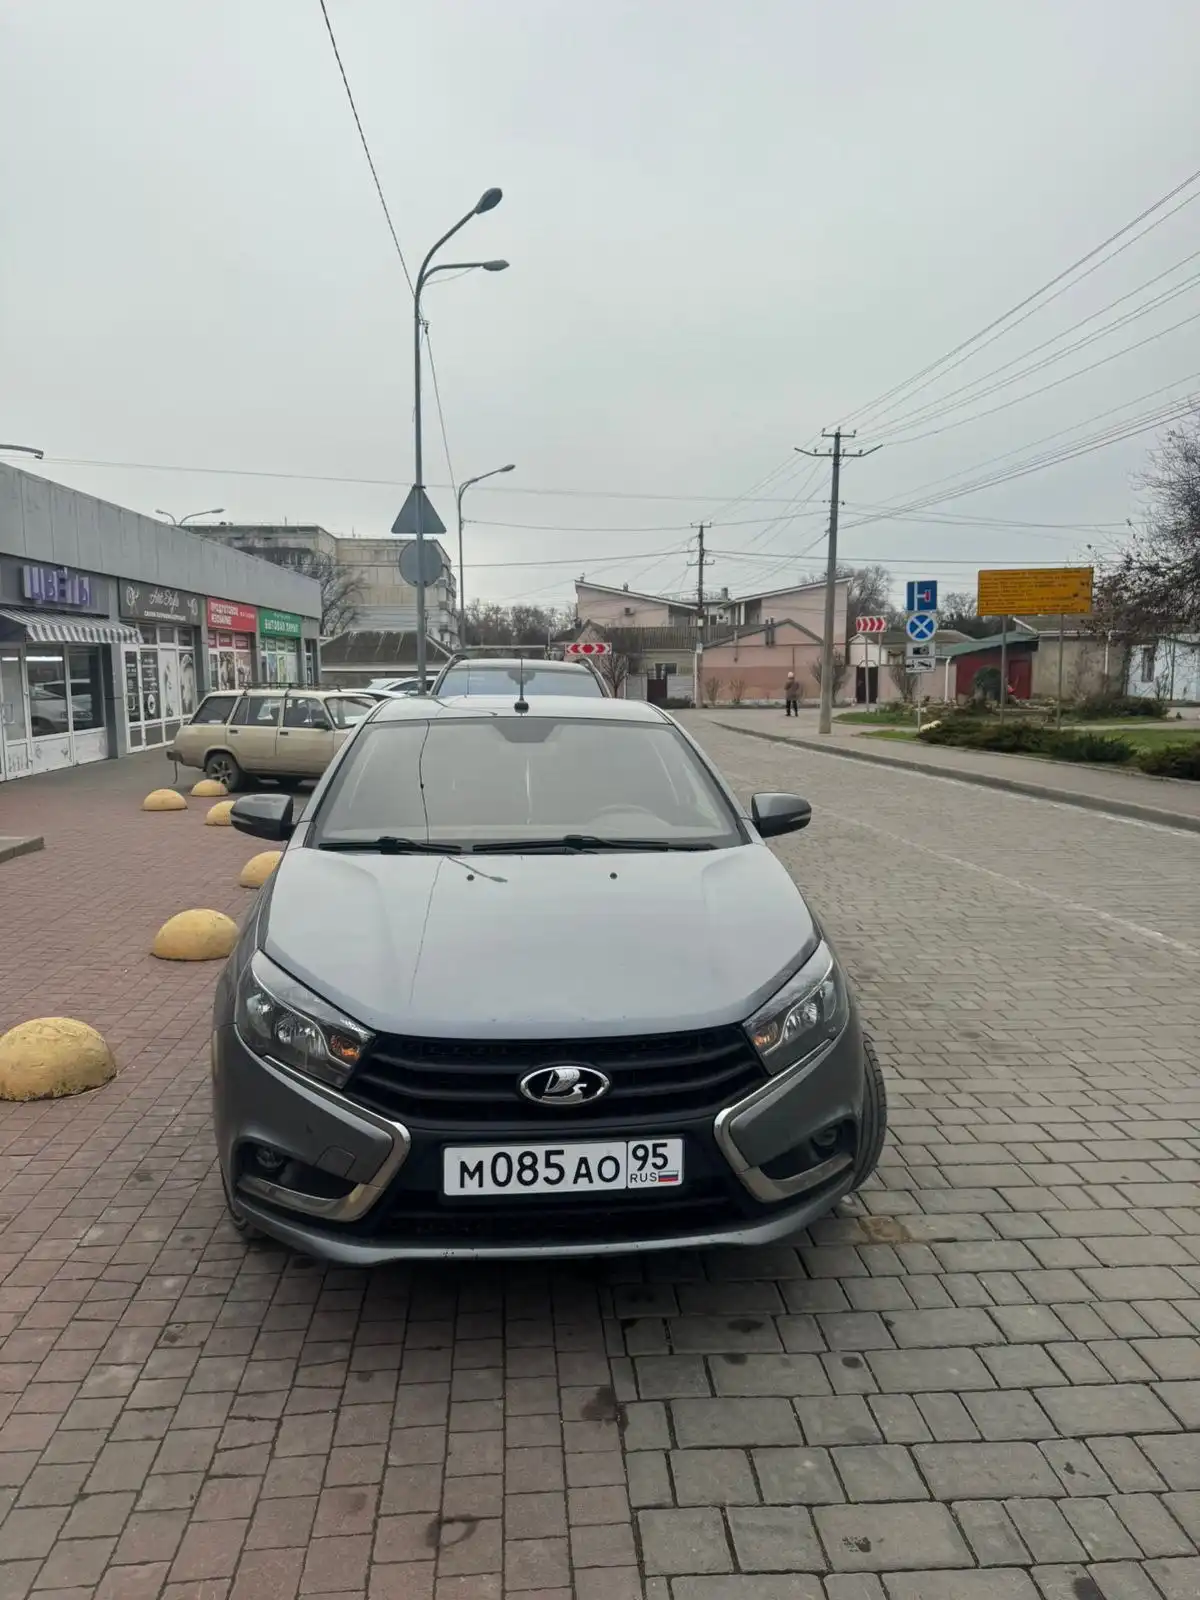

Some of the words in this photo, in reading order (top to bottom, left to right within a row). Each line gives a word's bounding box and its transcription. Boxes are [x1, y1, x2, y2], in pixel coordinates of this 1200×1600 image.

[459, 1149, 621, 1189] М085АО
[631, 1142, 669, 1172] 95
[630, 1172, 657, 1183] RUS
